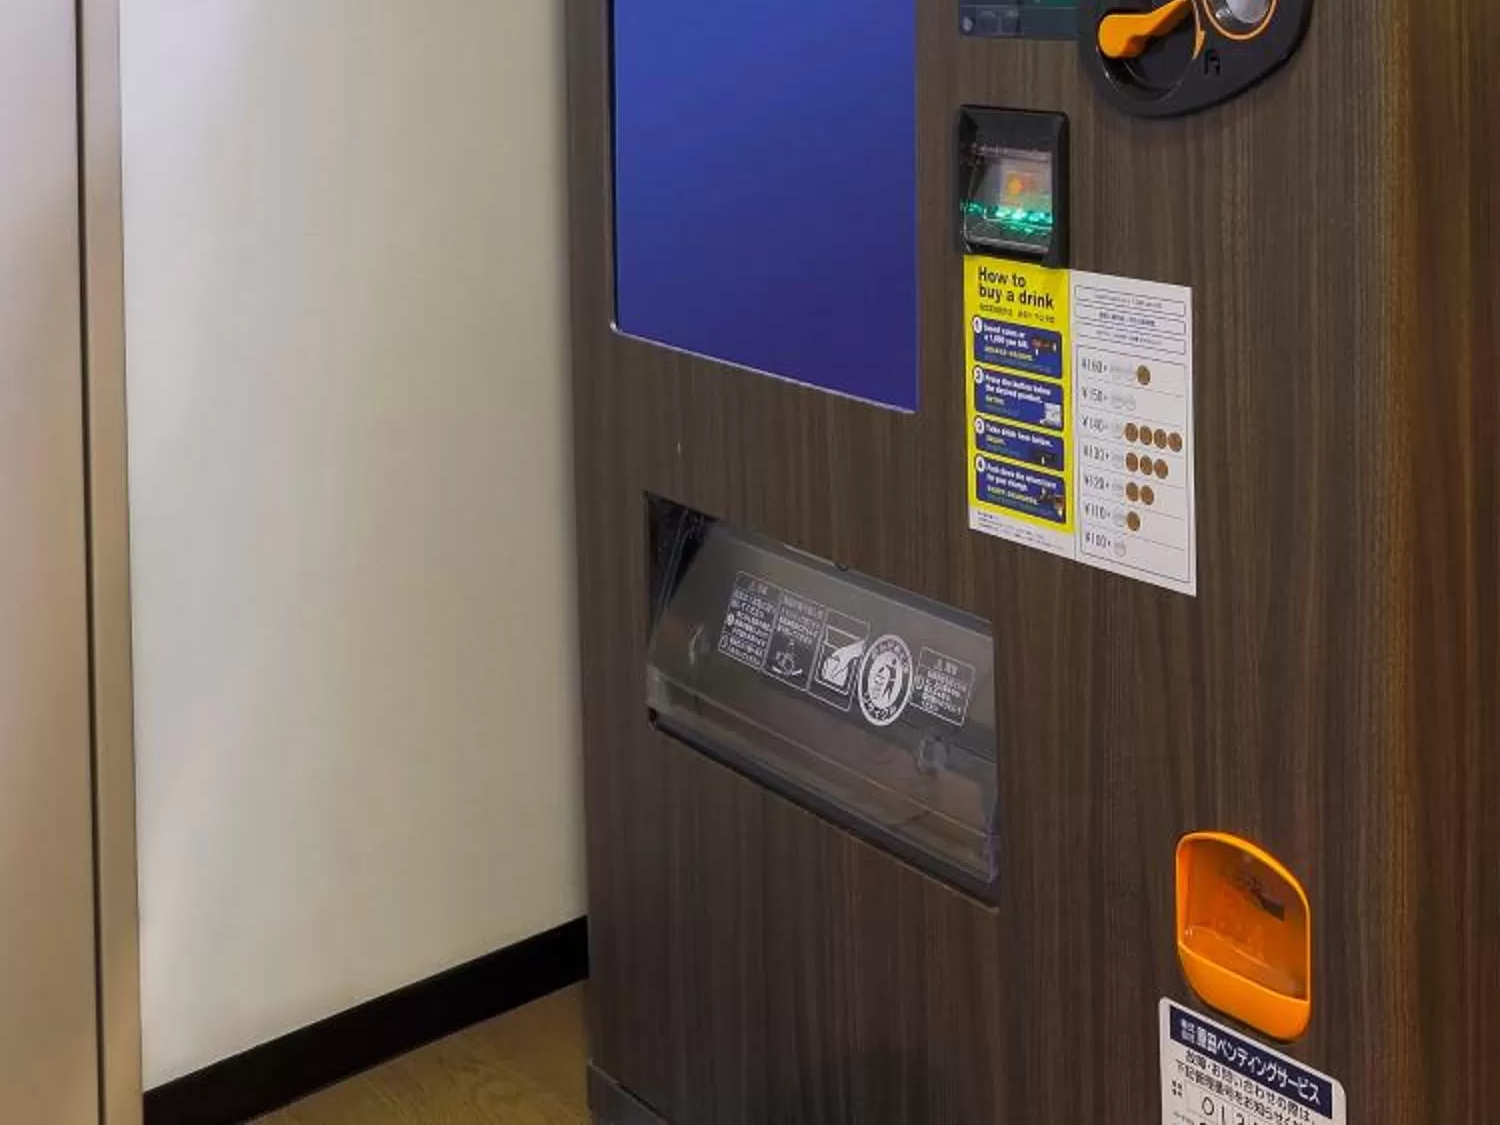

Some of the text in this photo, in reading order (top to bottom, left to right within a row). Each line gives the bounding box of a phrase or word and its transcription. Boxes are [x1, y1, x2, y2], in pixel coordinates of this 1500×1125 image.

[977, 266, 1026, 288] How to
[978, 283, 1054, 309] buy a drink
